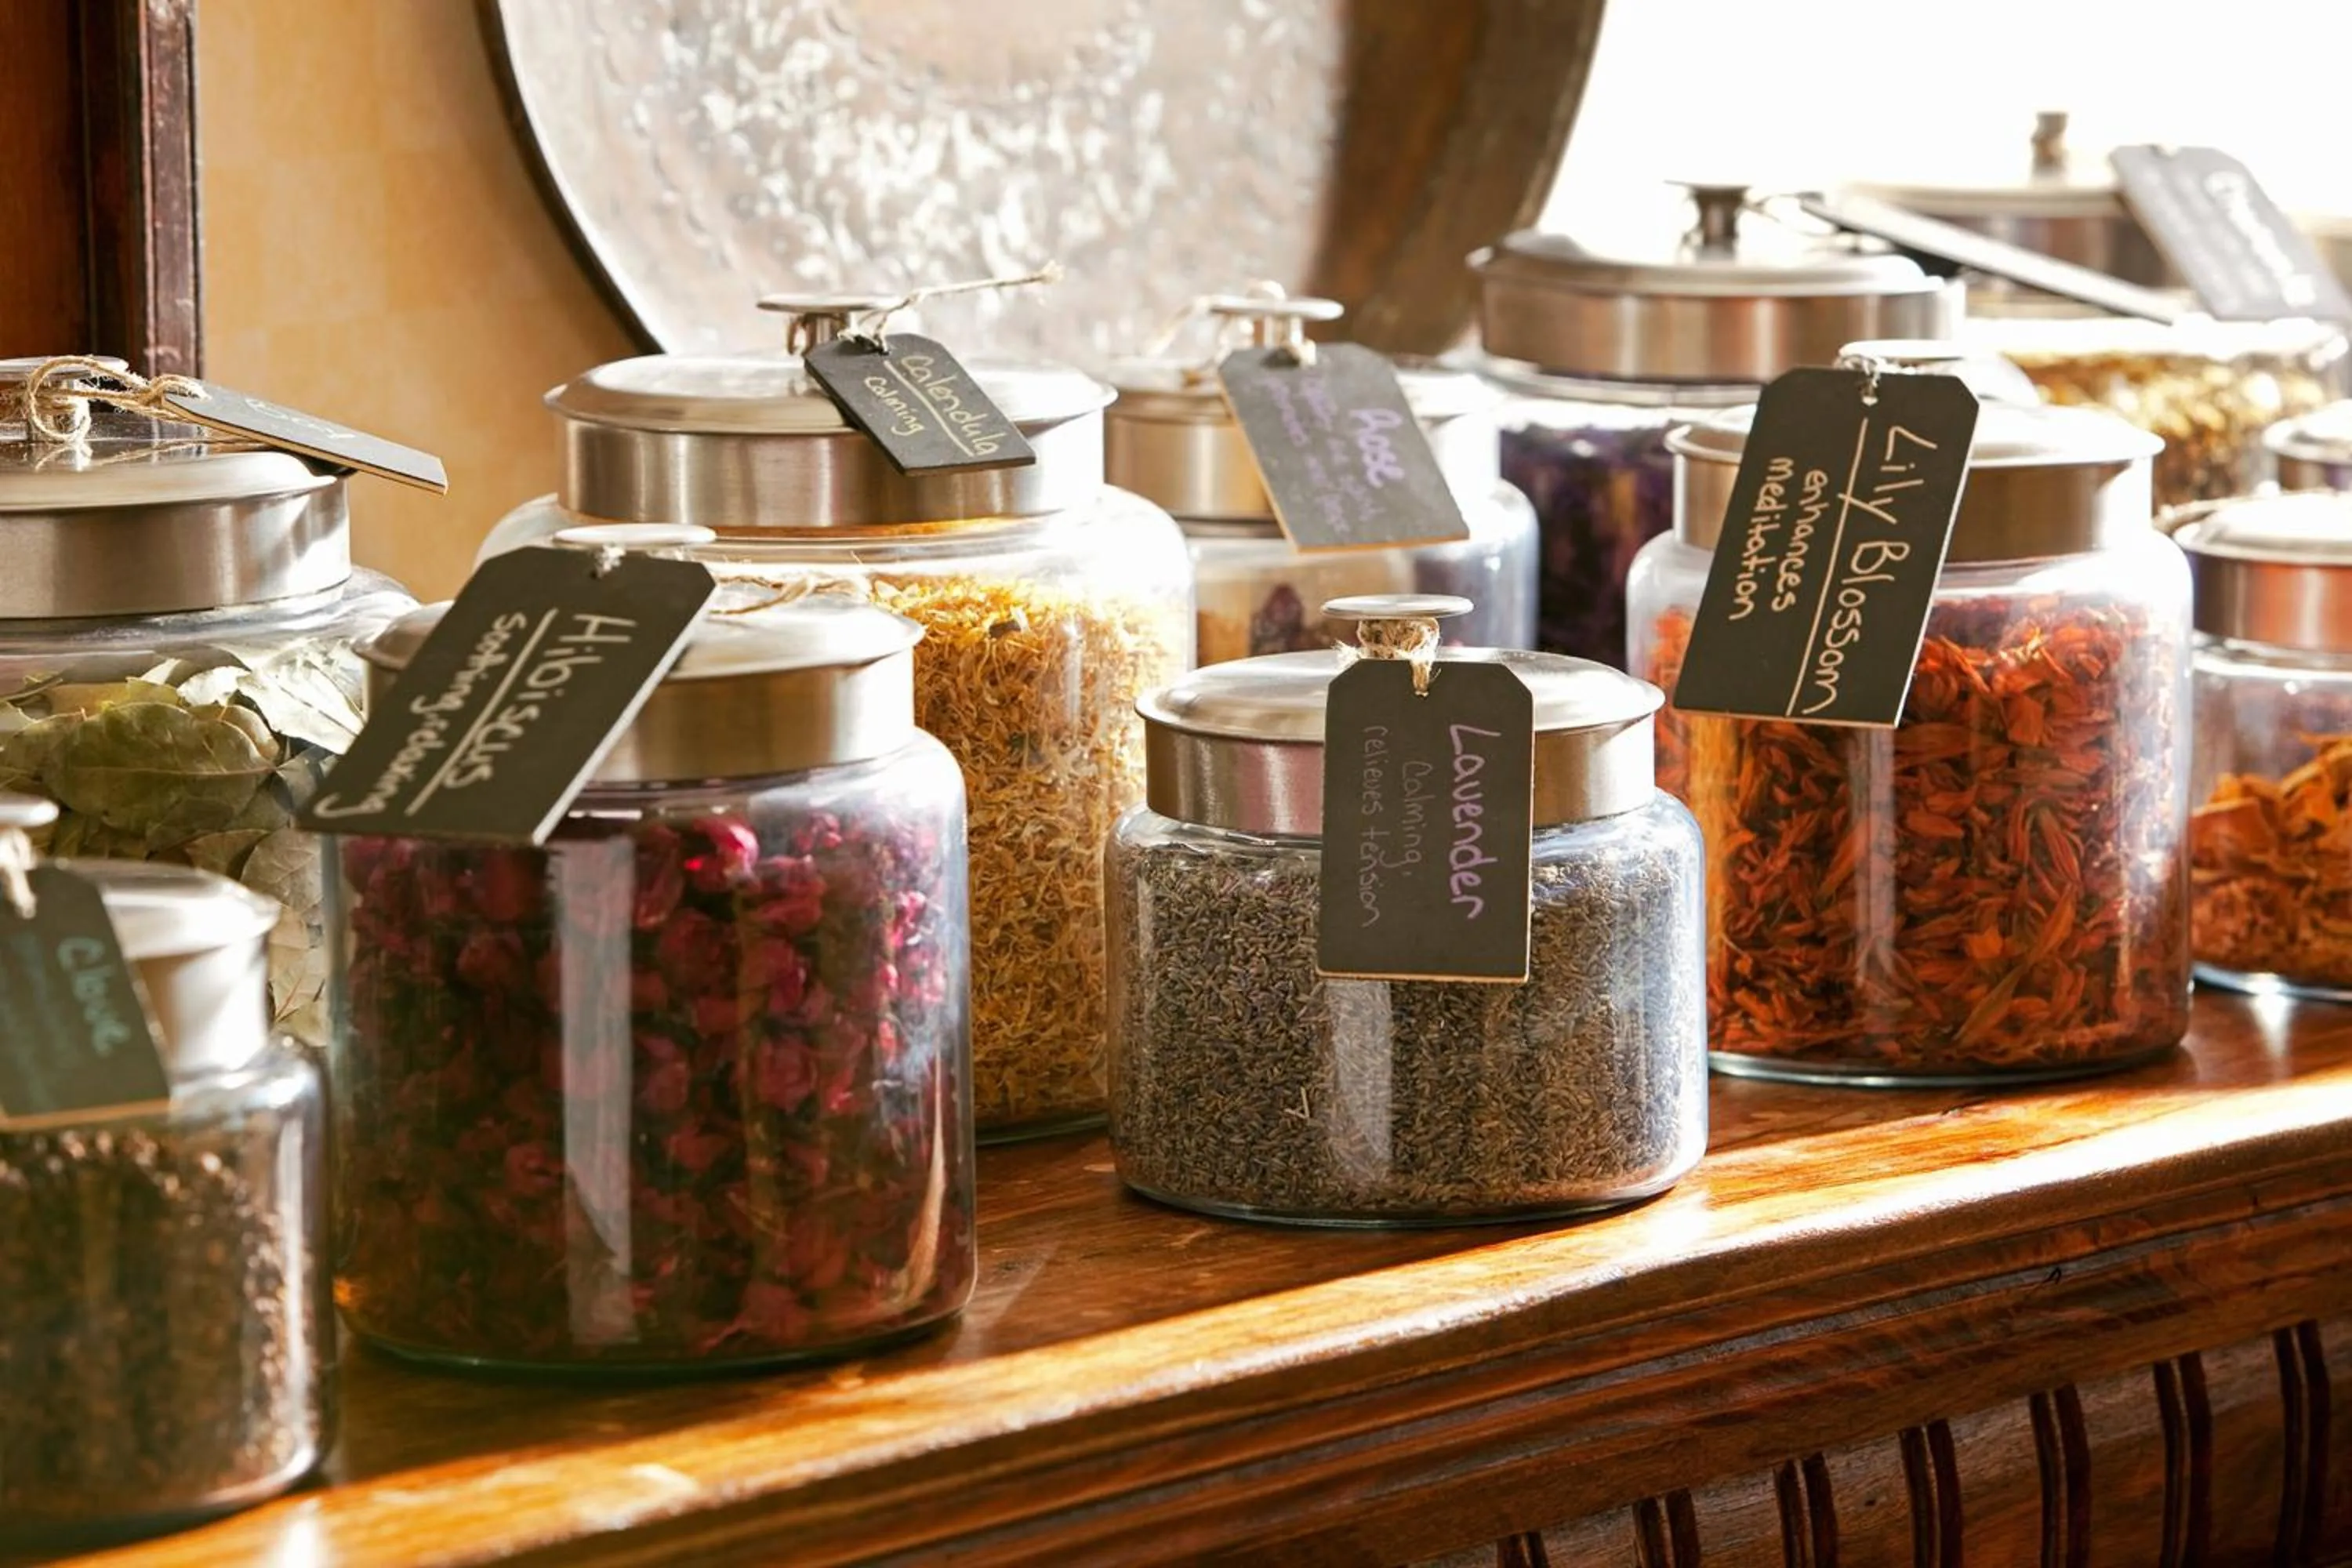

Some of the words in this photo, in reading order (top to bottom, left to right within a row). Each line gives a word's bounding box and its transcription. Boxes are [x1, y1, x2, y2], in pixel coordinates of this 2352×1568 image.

[901, 354, 1007, 456] Calendula
[1348, 407, 1406, 488] Rose
[1837, 425, 1939, 524] Lily
[1770, 469, 1831, 613] enhances
[1802, 539, 1911, 716] Blossom
[444, 612, 637, 789] Hibiscus
[1360, 725, 1390, 816] relieves
[1448, 724, 1502, 921] Lavender
[1359, 826, 1391, 928] tension
